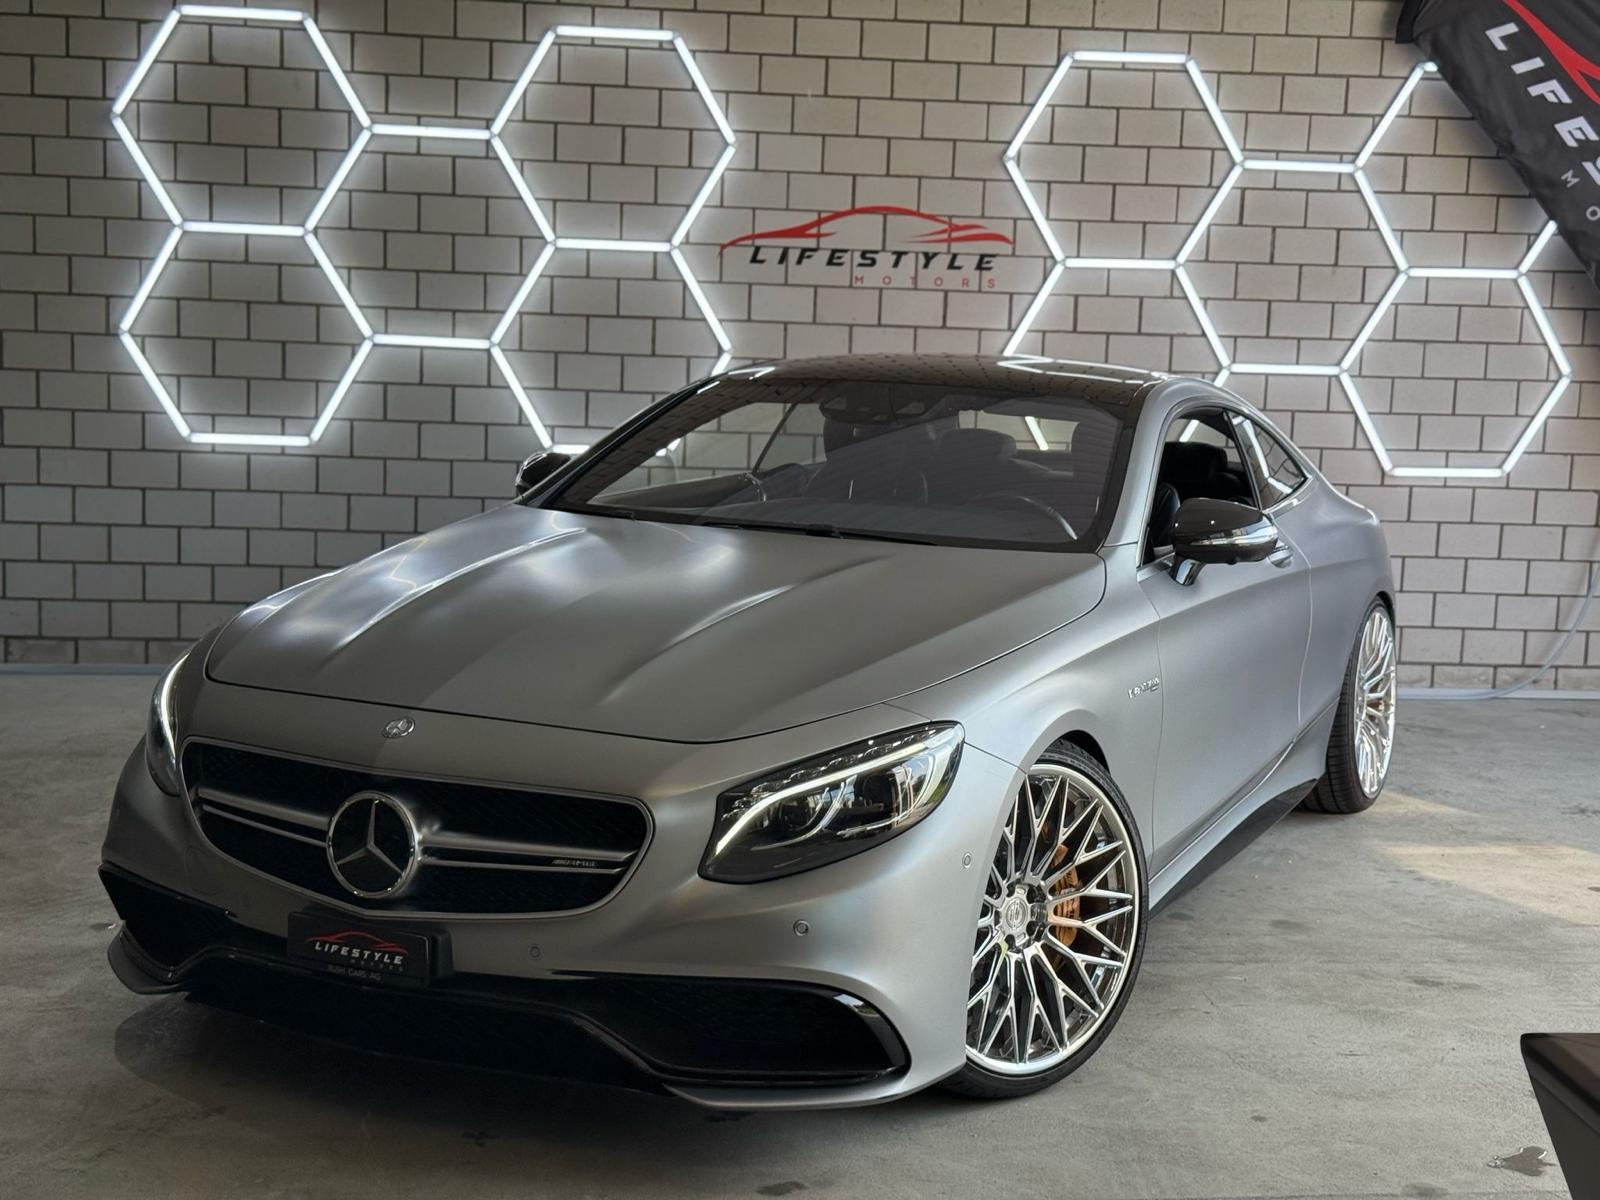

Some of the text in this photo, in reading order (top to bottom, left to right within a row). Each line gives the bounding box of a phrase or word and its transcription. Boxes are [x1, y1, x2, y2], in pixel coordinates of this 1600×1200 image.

[749, 246, 999, 270] LIFESTYLE
[855, 276, 996, 289] MOTORS
[314, 941, 404, 965] LIFESTYLE
